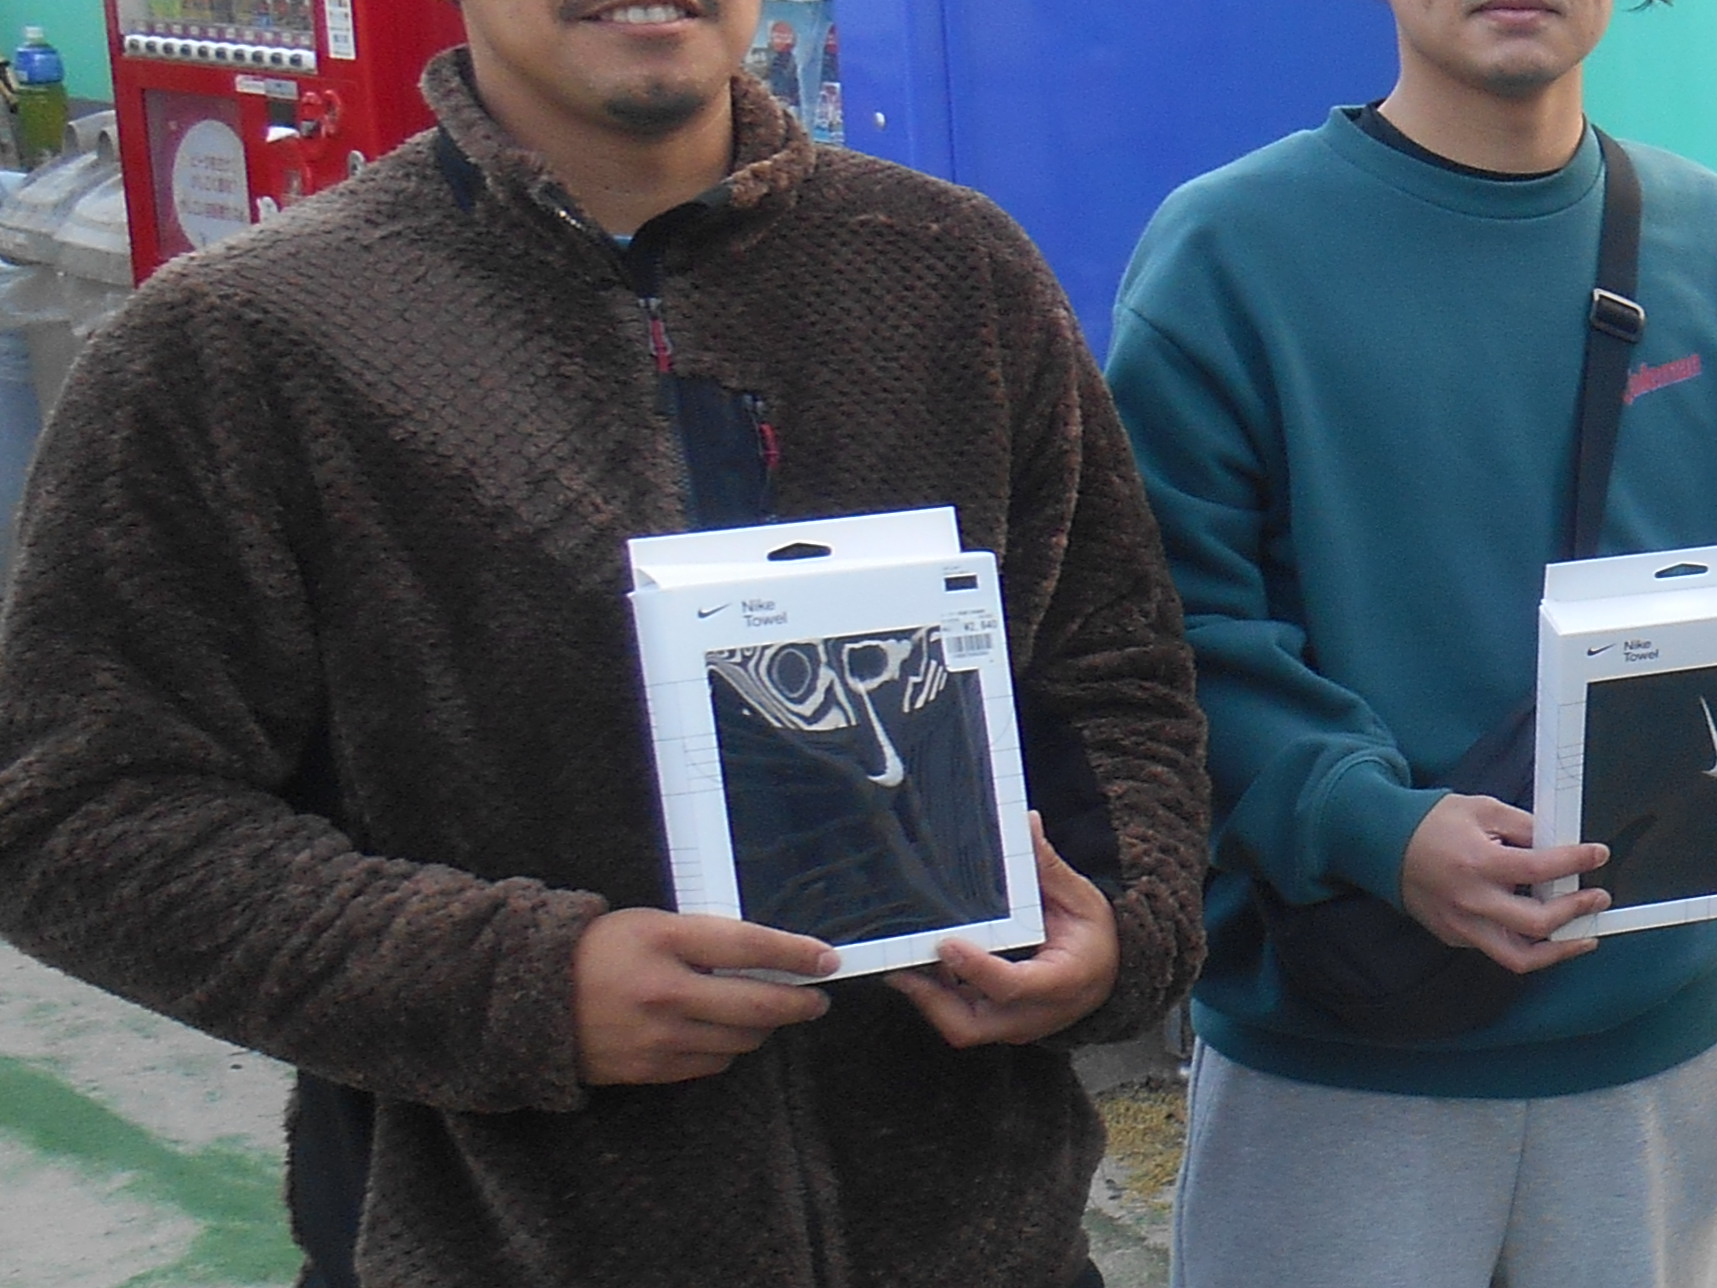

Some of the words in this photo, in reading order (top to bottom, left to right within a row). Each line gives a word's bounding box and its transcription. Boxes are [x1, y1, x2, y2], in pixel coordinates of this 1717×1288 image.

[741, 598, 776, 614] Nike
[743, 611, 788, 628] Towel
[1623, 639, 1652, 652] Nike
[1624, 648, 1660, 663] Towel
